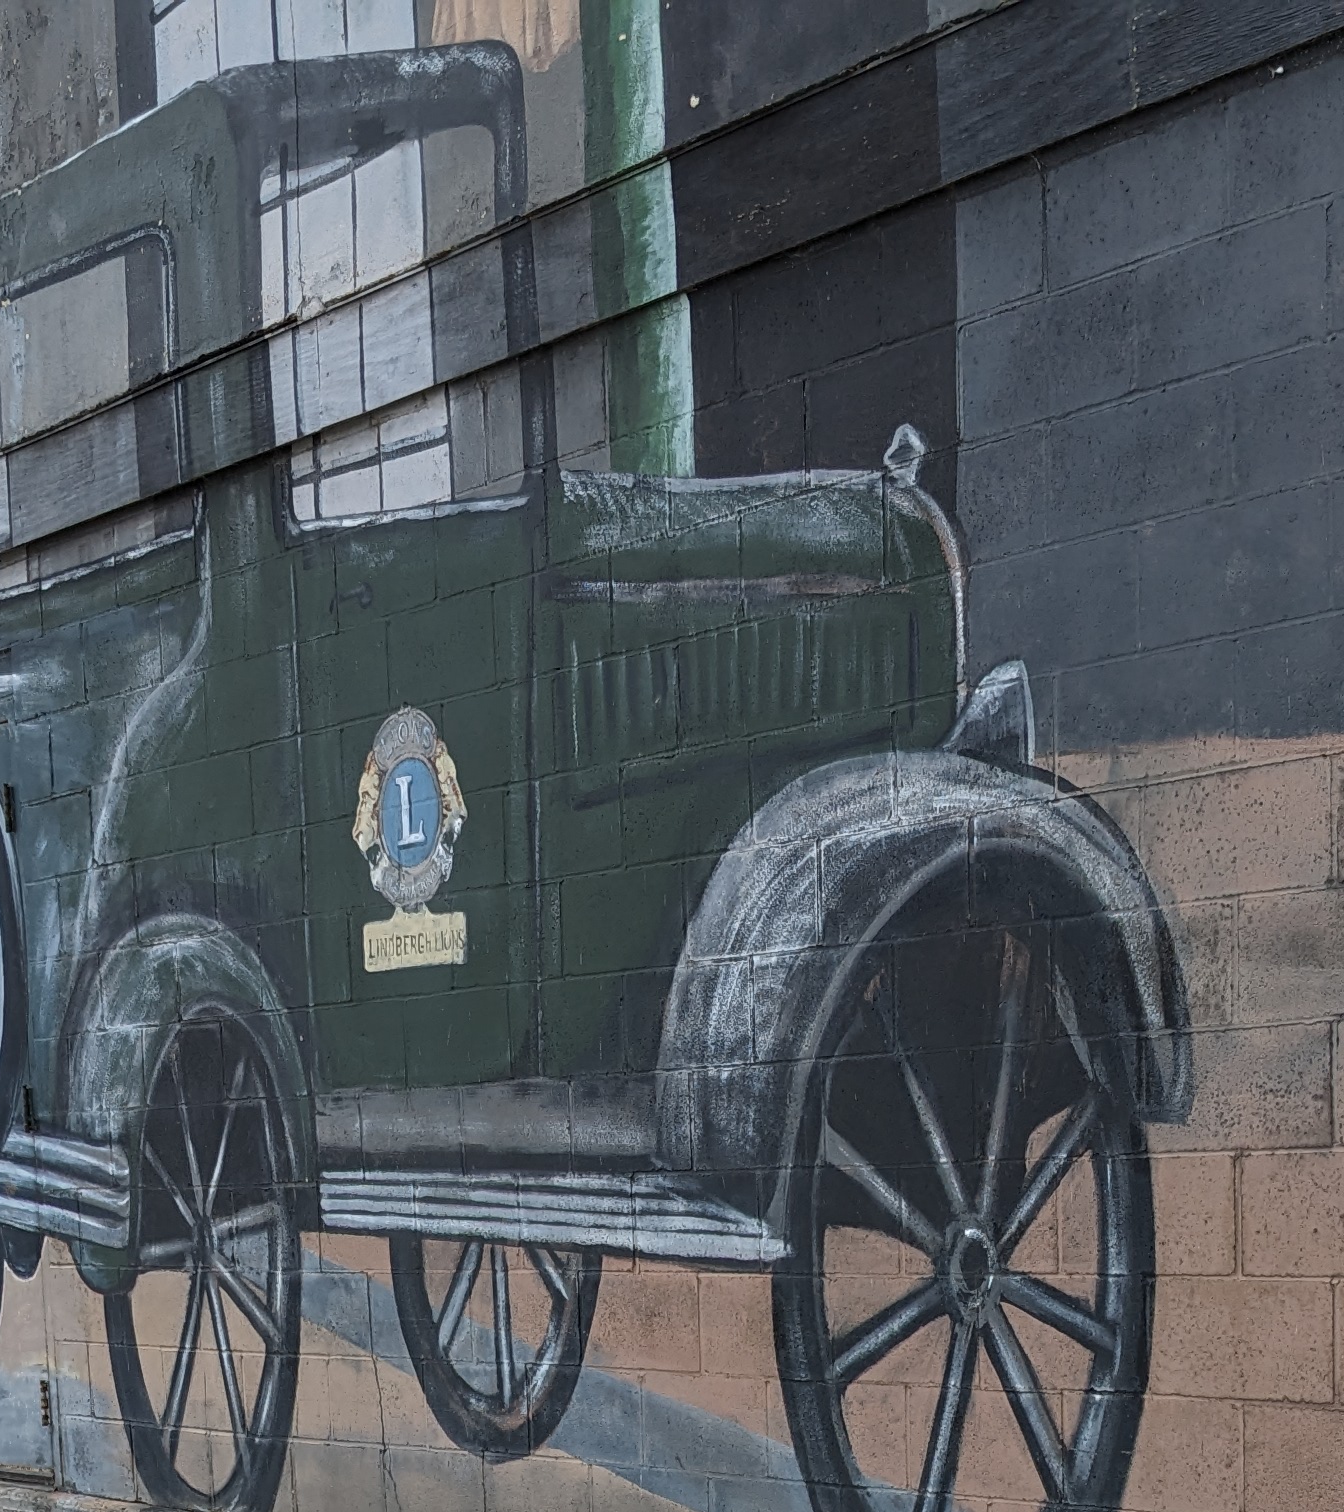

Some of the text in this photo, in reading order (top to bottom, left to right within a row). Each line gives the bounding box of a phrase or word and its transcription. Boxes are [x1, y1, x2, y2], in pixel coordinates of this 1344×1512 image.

[380, 720, 431, 761] LIONS
[395, 775, 427, 847] L
[368, 928, 465, 959] LINDBERGH LIONS
